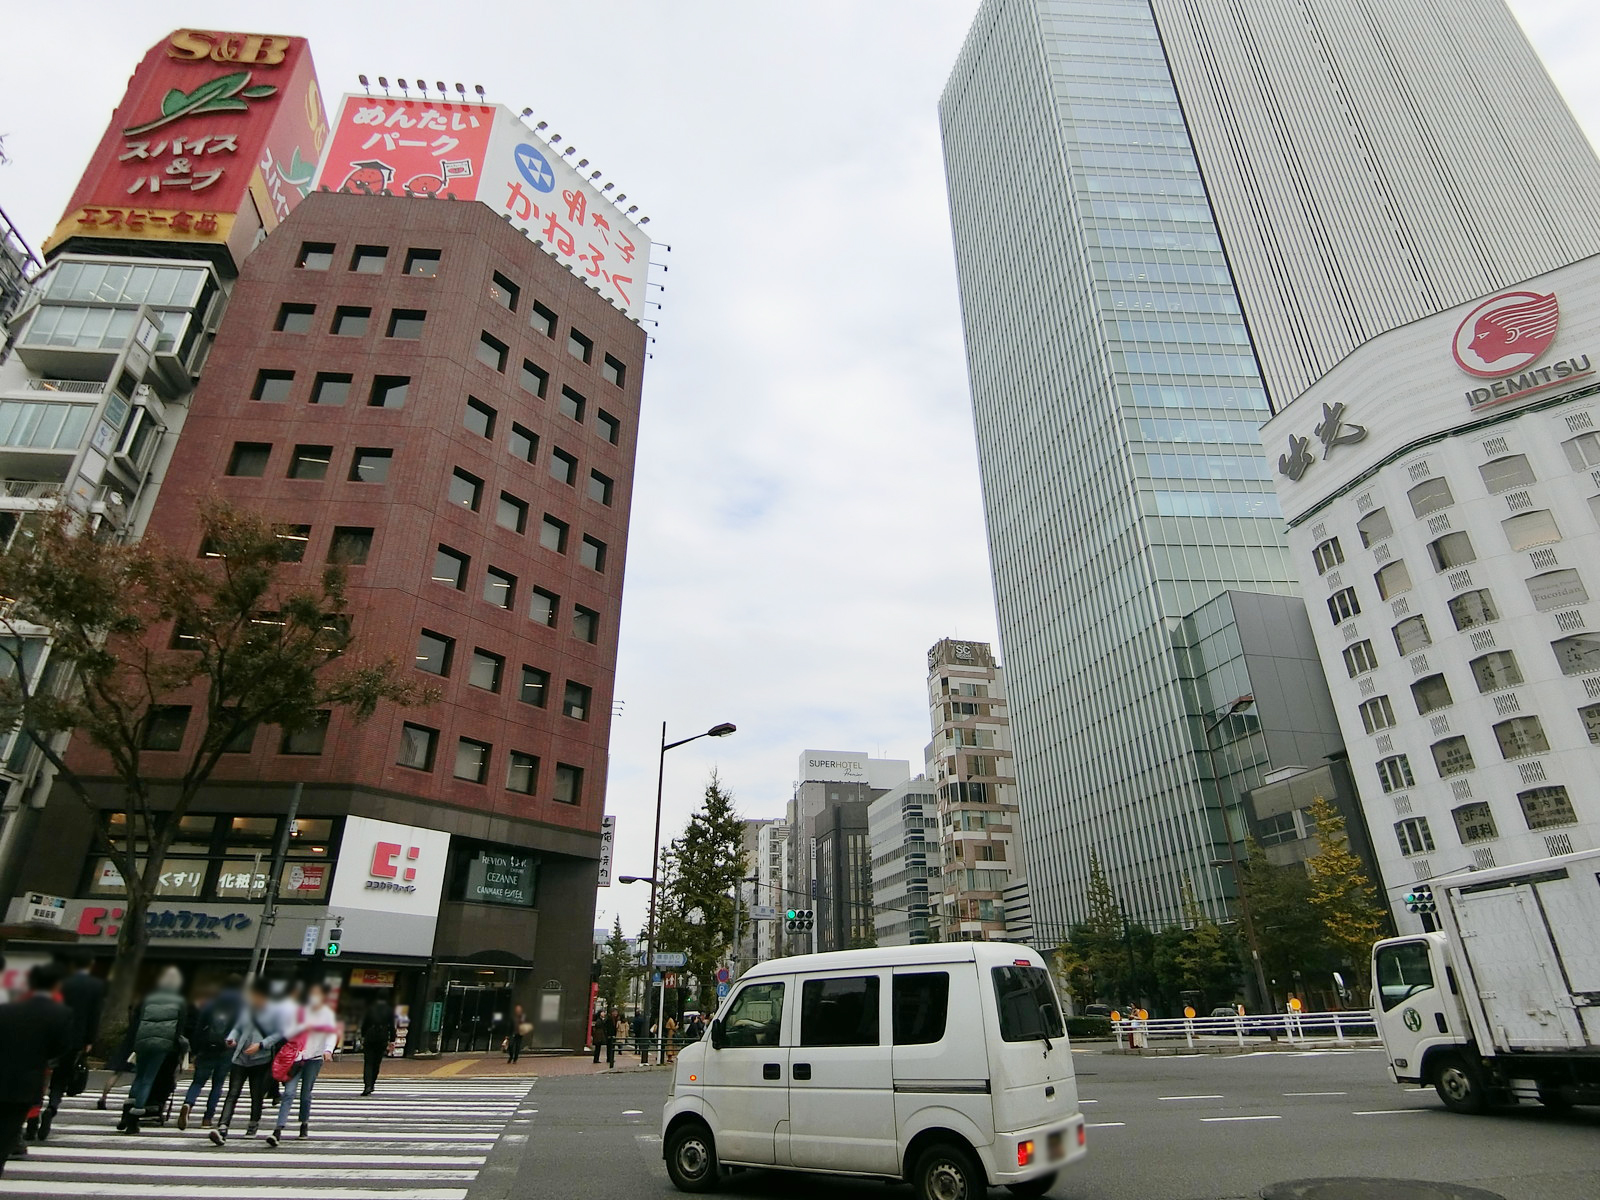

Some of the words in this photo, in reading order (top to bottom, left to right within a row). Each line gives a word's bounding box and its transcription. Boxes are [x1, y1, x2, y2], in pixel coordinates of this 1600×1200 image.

[167, 29, 290, 65] S&B
[352, 105, 481, 132] めんたい
[119, 134, 239, 162] スパイス
[361, 132, 459, 157] パーク
[165, 157, 191, 175] &
[77, 208, 219, 233] エスビー食品
[505, 181, 633, 306] かねふく
[1464, 354, 1592, 408] IDEMITSU
[955, 645, 971, 655] SC
[809, 760, 863, 769] SUPERHOTEL
[1466, 822, 1494, 841] 眼科
[482, 855, 507, 867] REVLON
[159, 871, 201, 887] くすり
[219, 873, 266, 889] 化粧品
[365, 880, 417, 894] ココカラファイン
[487, 871, 518, 885] CEZANNE
[476, 886, 503, 897] CANMAKE
[144, 910, 252, 931] コカラファイン
